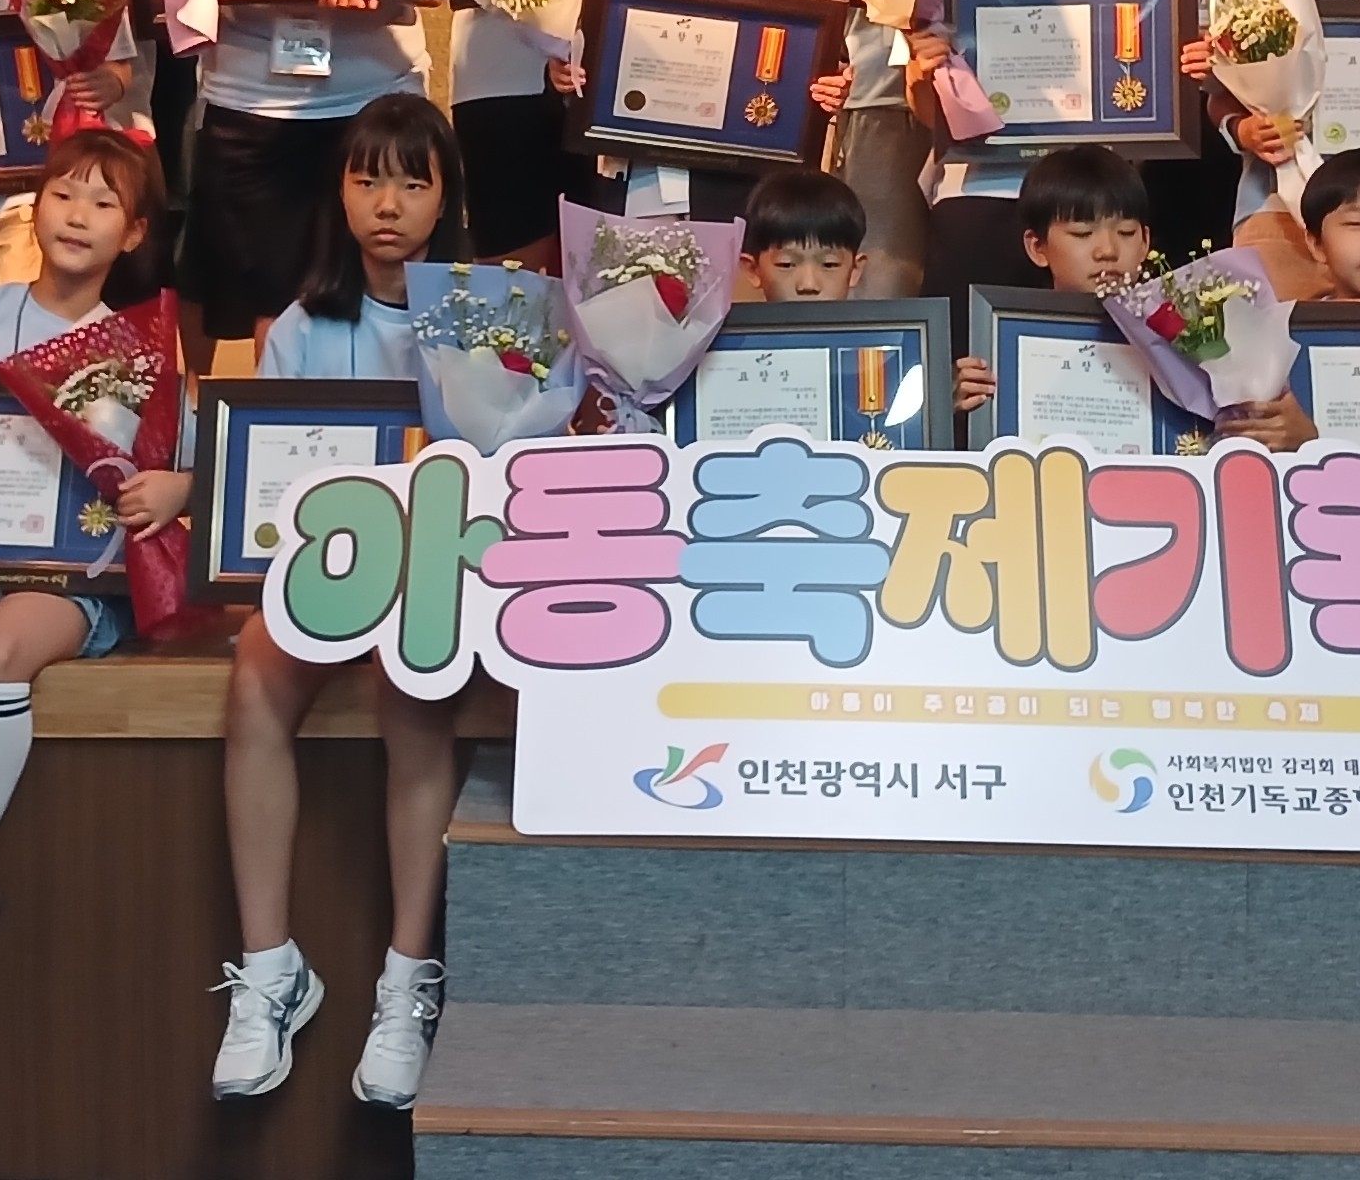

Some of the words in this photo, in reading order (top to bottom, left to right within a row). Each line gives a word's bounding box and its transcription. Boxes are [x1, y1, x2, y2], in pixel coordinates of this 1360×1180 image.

[1167, 754, 1274, 774] 사회복지법인
[738, 759, 919, 798] 인천광역시
[934, 763, 1007, 800] 서구
